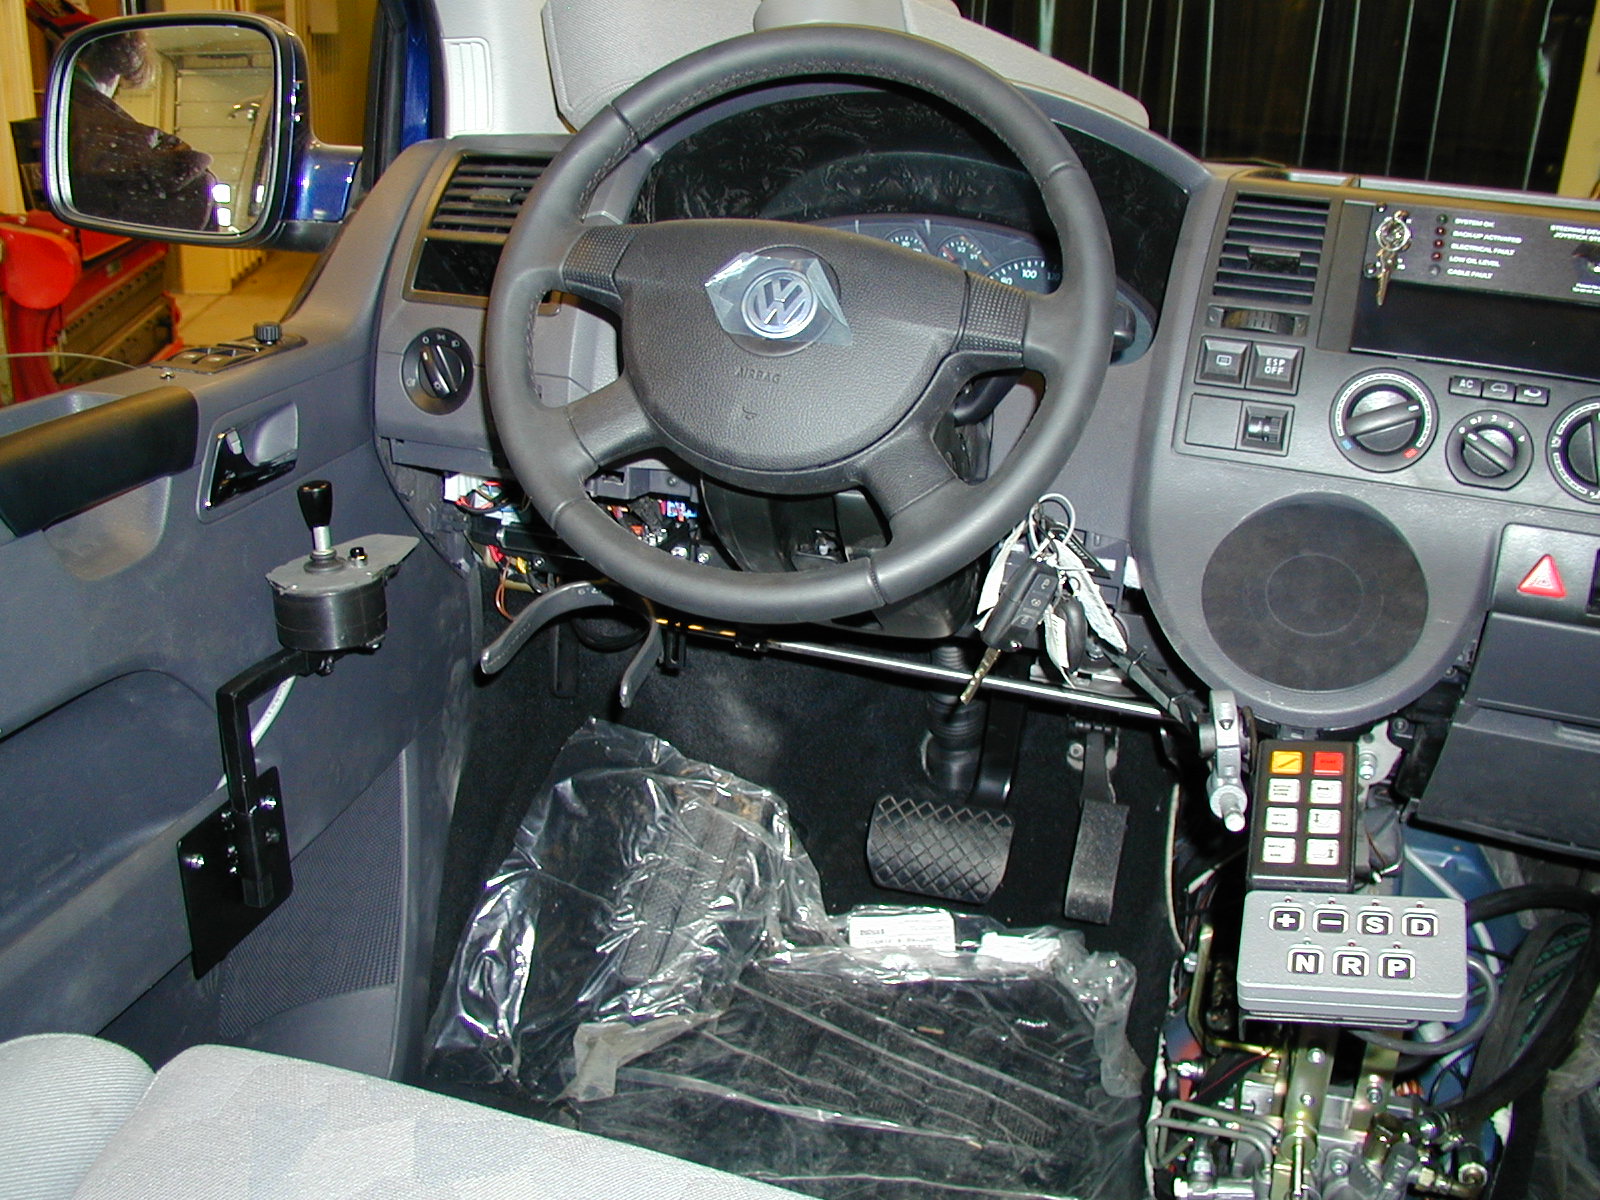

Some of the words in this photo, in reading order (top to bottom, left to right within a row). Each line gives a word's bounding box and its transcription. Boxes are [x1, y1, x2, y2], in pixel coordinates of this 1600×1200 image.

[1454, 218, 1483, 227] SYSTEM
[1451, 243, 1493, 254] ELECTRICAL
[1493, 248, 1515, 256] FAULT
[1478, 259, 1500, 267] LEVEL
[1022, 269, 1037, 279] 100
[1471, 271, 1493, 279] FAULT
[1265, 358, 1286, 366] ESP
[734, 365, 782, 384] AIRBAG
[1264, 366, 1285, 375] OFF
[1459, 379, 1474, 388] AC
[1365, 916, 1385, 933] S
[1410, 918, 1431, 935] D
[1295, 955, 1316, 973] N
[1341, 957, 1362, 976] R
[1387, 959, 1407, 977] P
